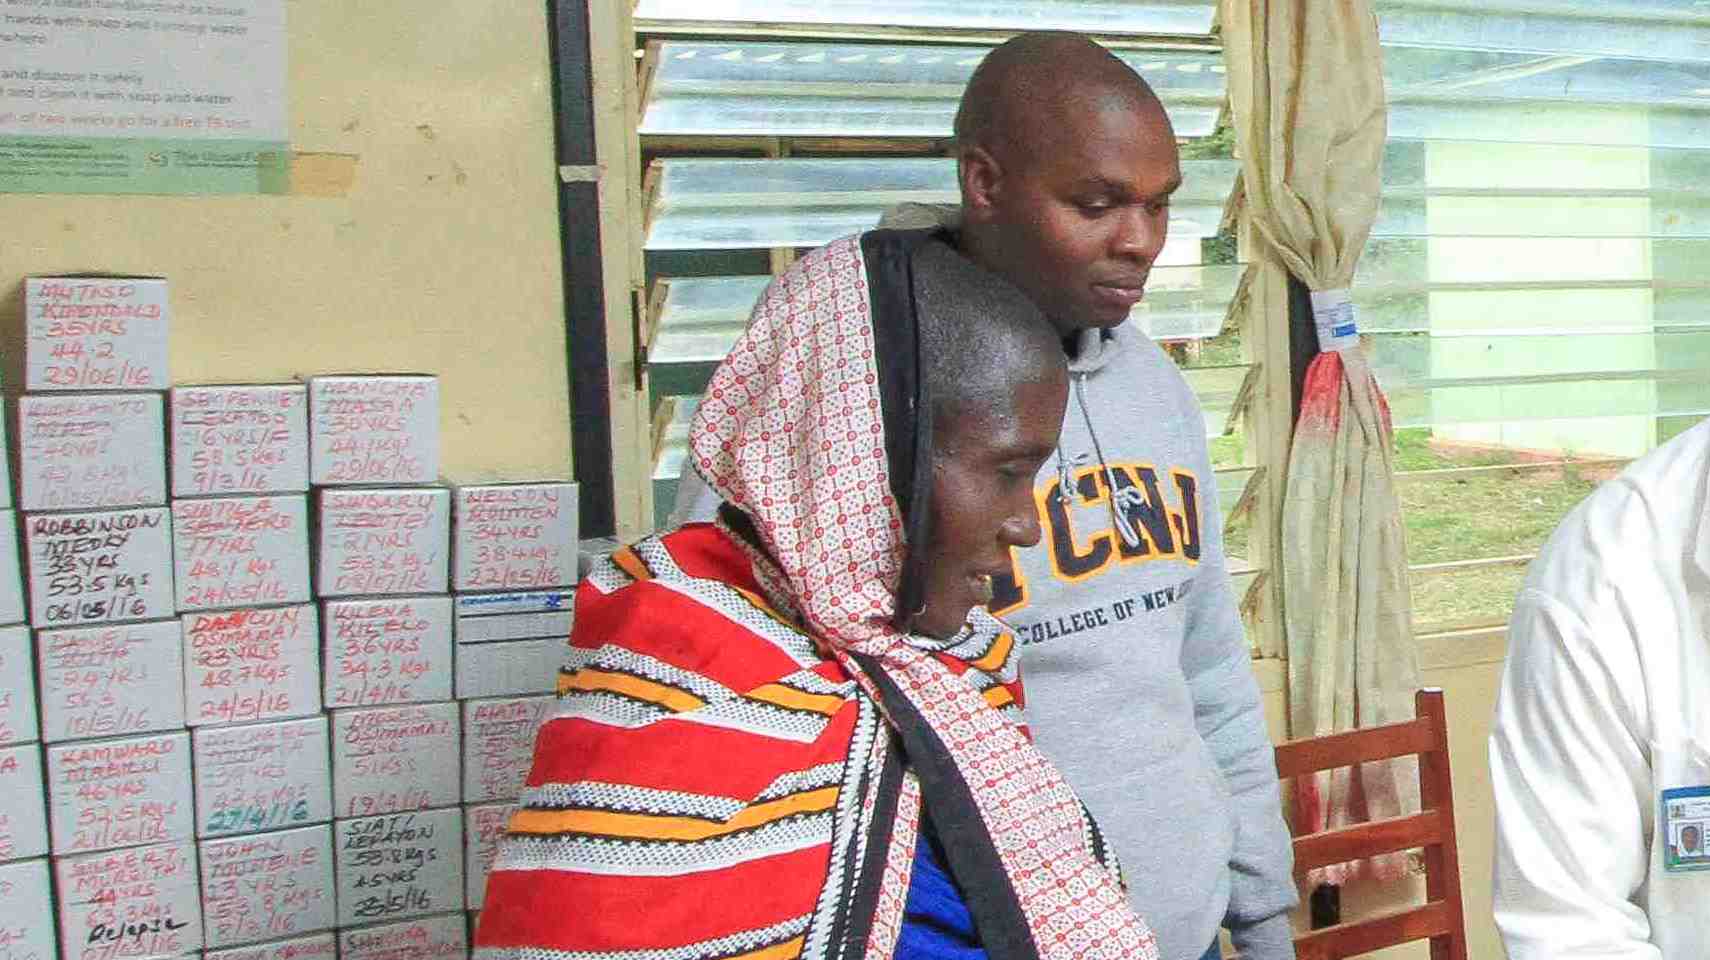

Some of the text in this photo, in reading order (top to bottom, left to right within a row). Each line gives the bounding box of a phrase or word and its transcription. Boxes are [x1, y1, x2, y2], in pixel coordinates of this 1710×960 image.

[464, 488, 560, 504] NELSON
[1016, 607, 1109, 647] COLLEGE
[1114, 601, 1137, 622] OF
[1142, 586, 1177, 611] NEW
